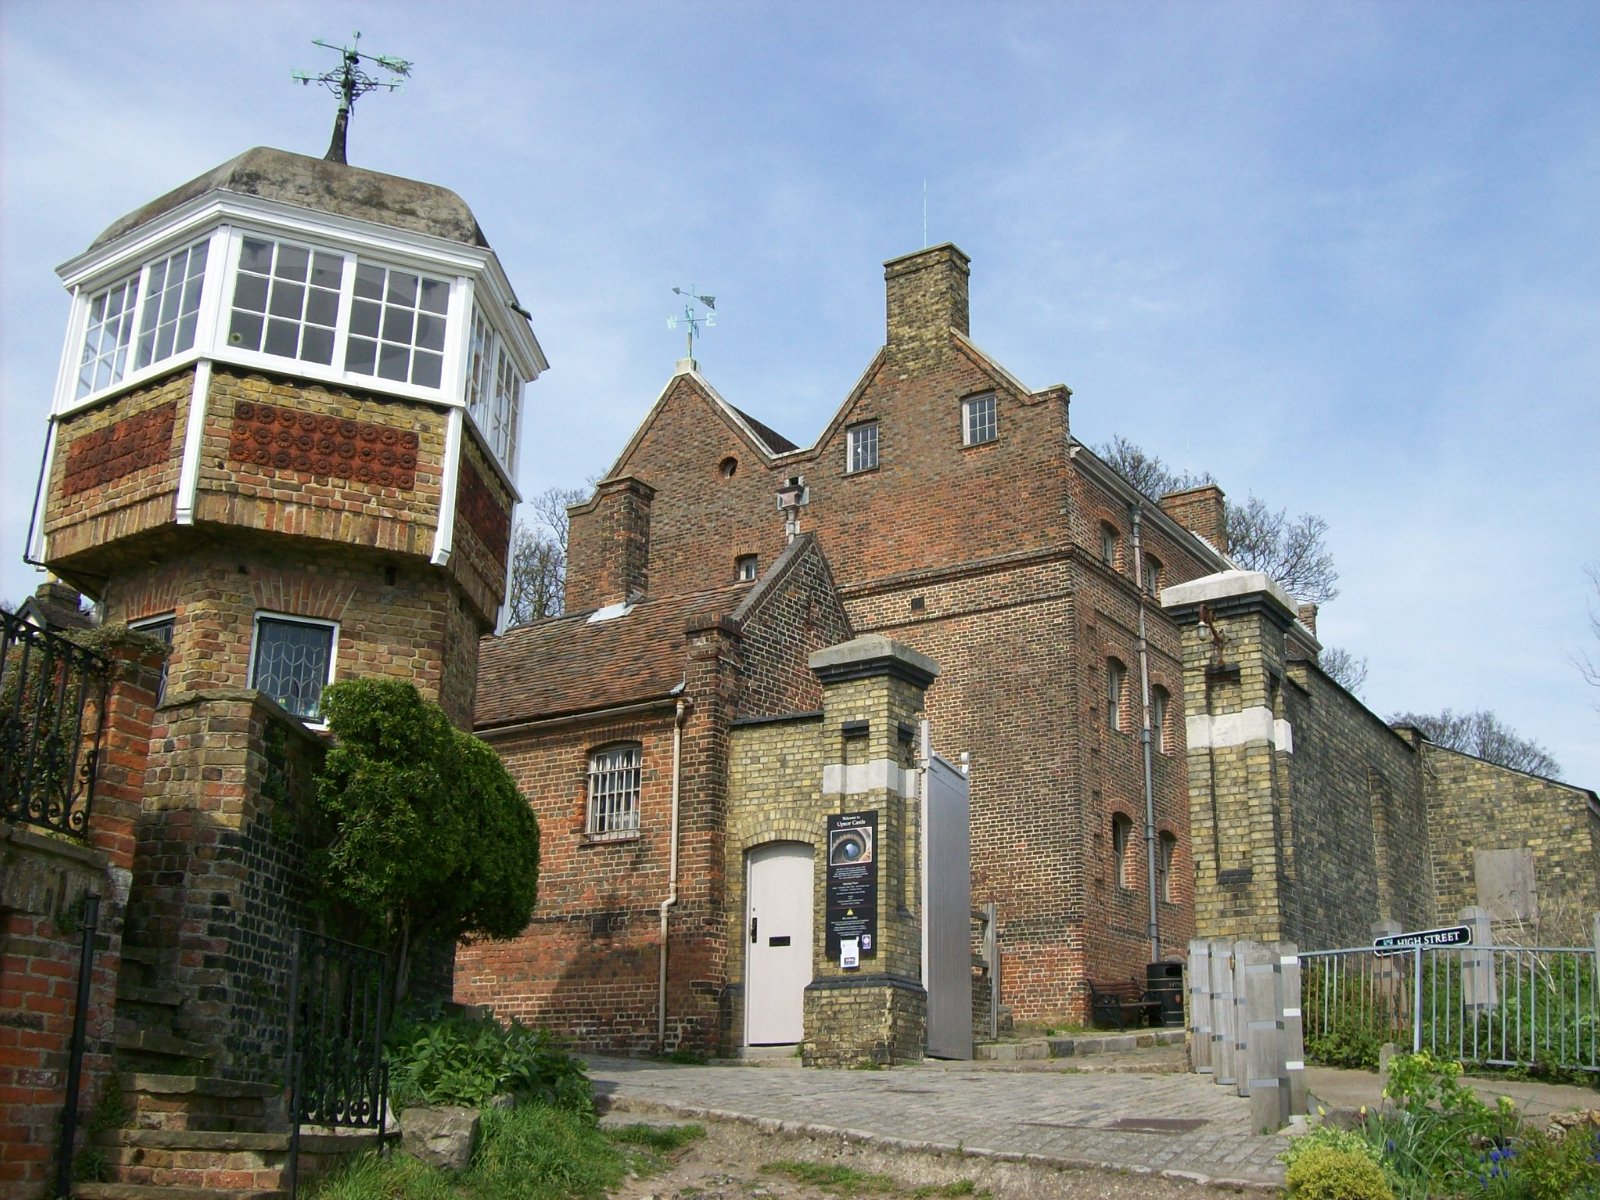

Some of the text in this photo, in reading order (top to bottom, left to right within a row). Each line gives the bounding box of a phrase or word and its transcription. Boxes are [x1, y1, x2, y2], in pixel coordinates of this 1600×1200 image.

[705, 312, 717, 327] E
[1397, 931, 1460, 946] HIGH STREET
